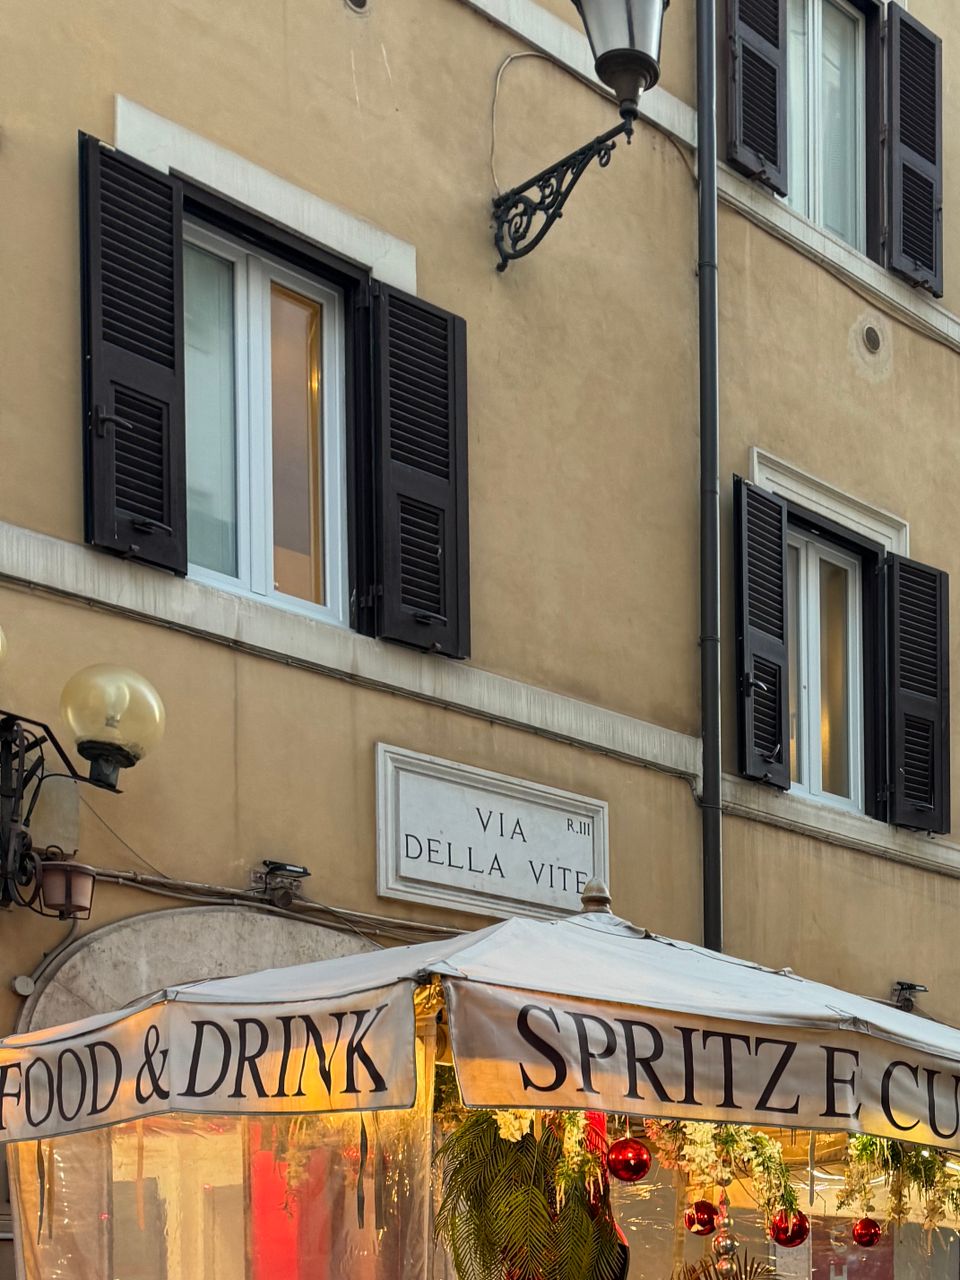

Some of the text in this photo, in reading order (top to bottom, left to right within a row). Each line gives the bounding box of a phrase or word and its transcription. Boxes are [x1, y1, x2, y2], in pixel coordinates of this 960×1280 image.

[476, 807, 527, 843] VIA
[567, 818, 591, 836] R.III
[404, 833, 588, 895] DELLA VITE
[0, 1003, 389, 1131] FOOD & DRINK
[516, 1004, 800, 1115] SPRITZ
[819, 1045, 863, 1118] E
